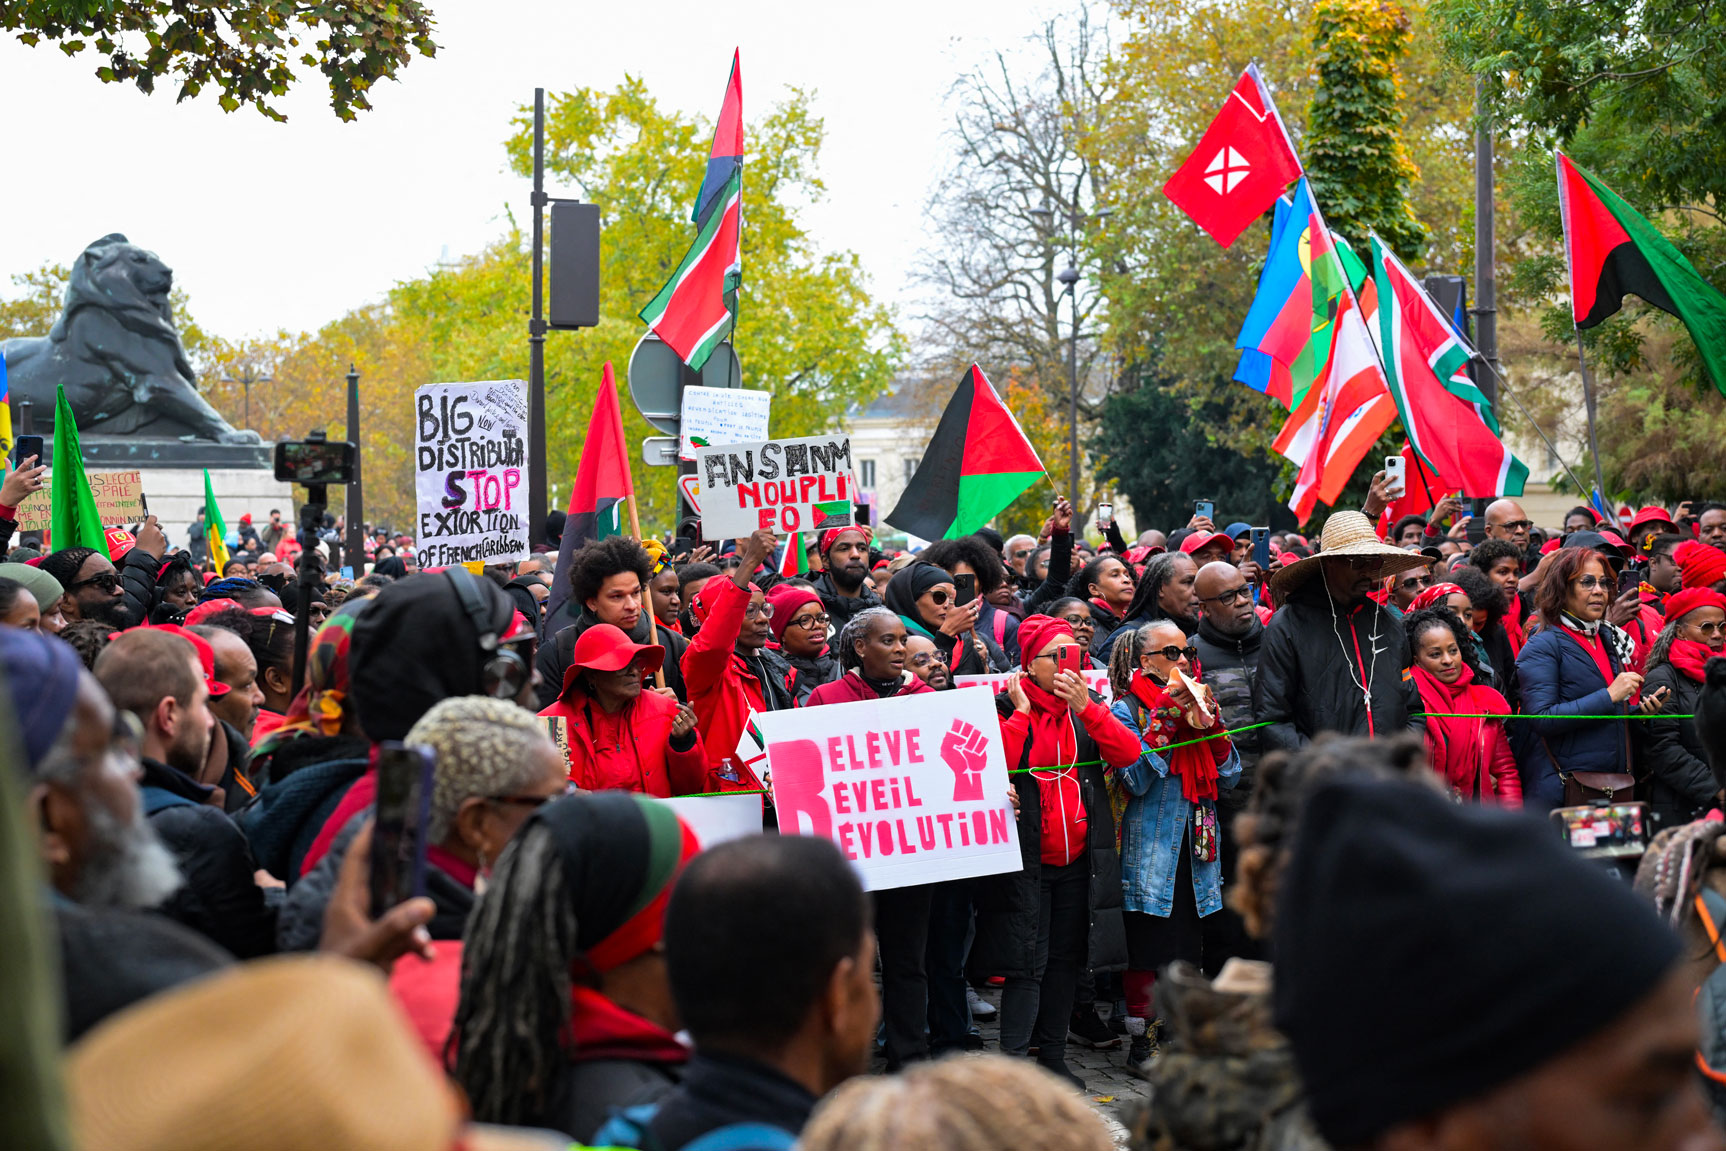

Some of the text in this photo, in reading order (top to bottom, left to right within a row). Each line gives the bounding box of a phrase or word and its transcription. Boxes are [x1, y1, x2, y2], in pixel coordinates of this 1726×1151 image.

[704, 438, 852, 488] ANSANM
[441, 468, 521, 512] STOP
[418, 544, 438, 568] OF
[438, 543, 482, 566] FRENCH
